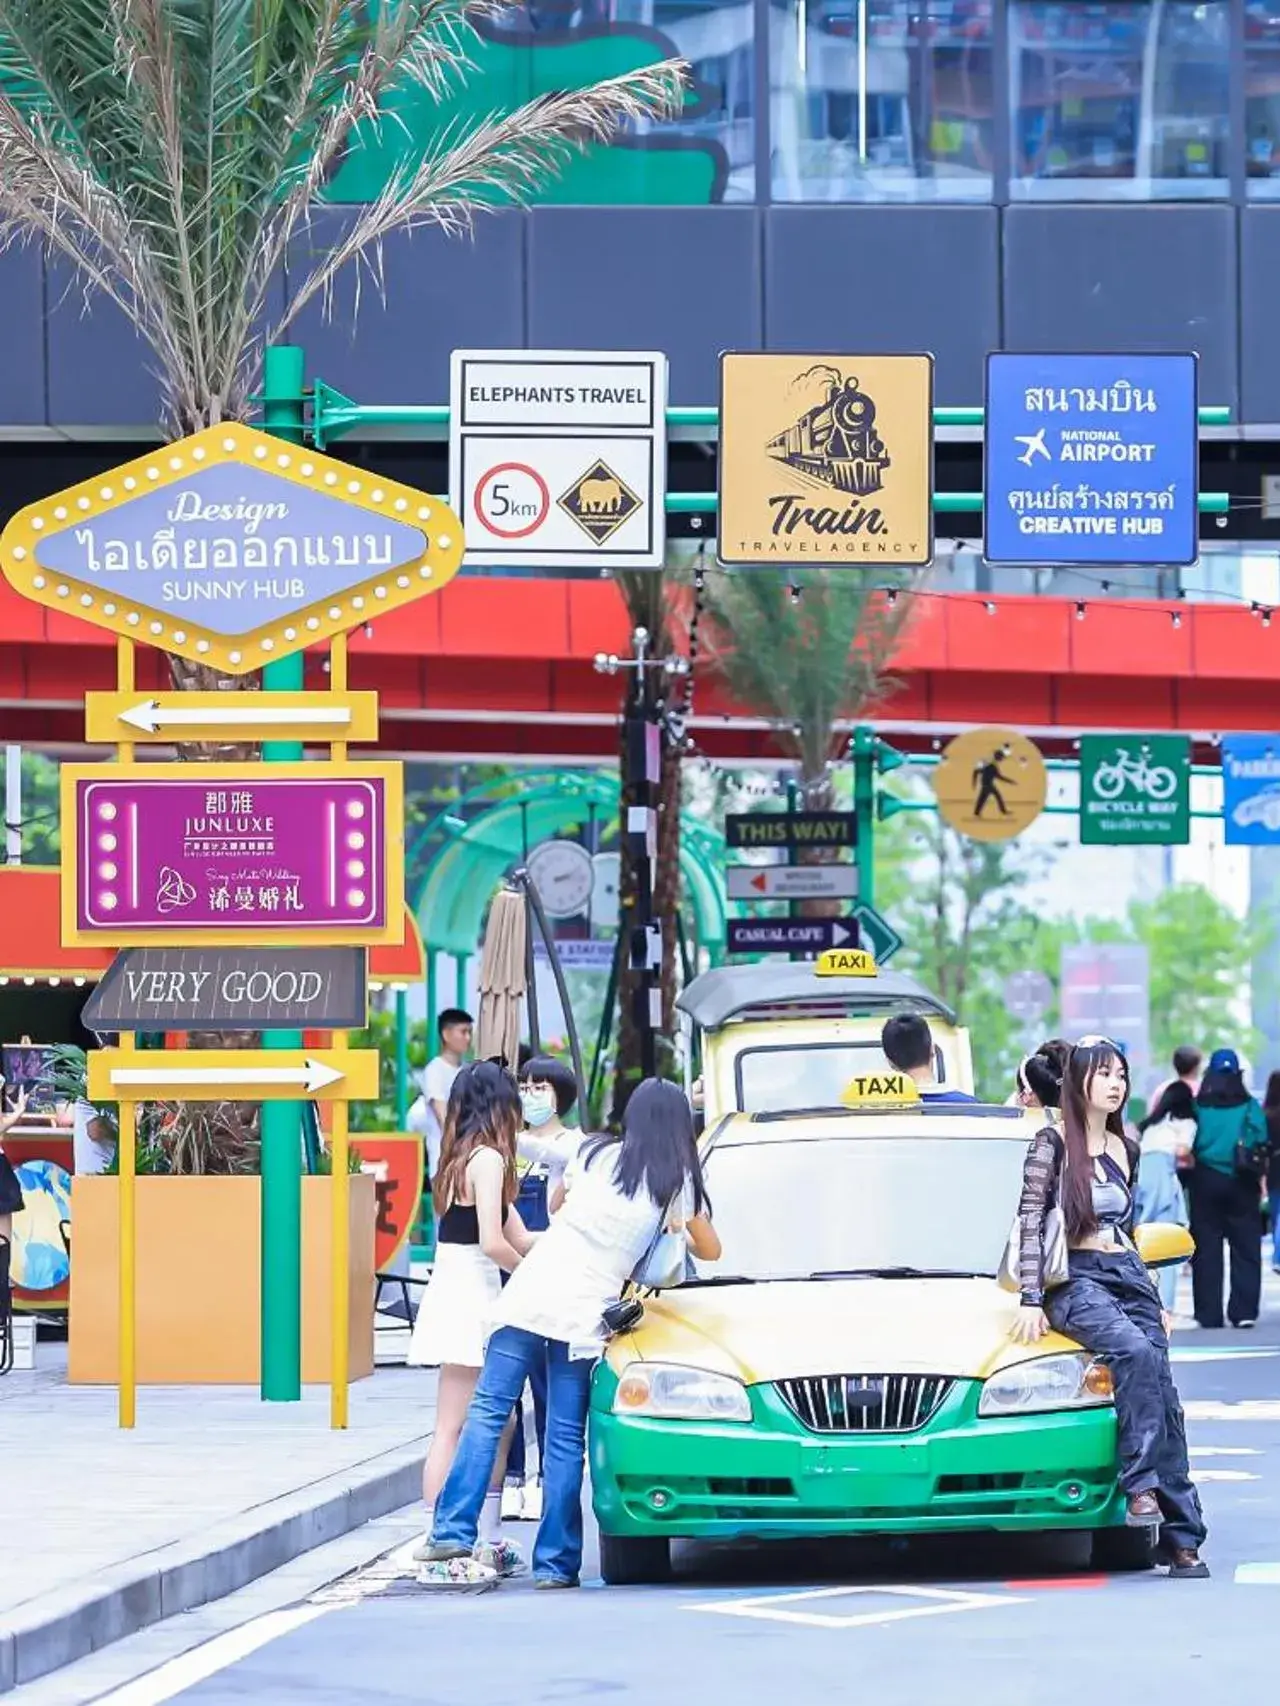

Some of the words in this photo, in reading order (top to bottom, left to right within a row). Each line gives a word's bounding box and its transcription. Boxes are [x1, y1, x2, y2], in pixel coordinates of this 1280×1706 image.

[470, 387, 575, 403] ELEPHANTS
[579, 387, 646, 404] TRAVEL
[1024, 380, 1157, 412] สนามบิน
[1061, 431, 1122, 441] NATIONAL
[1060, 444, 1155, 461] AIRPORT
[1008, 483, 1176, 516] ศูนย์สร้างสรรค์
[167, 491, 289, 533] Design
[768, 495, 888, 535] Train.
[1019, 517, 1116, 534] CREATIVE
[1122, 517, 1163, 535] HUB
[74, 526, 392, 571] ไอเดียออกแบบ
[162, 581, 248, 601] SUNNY
[254, 579, 305, 599] HUB
[1087, 801, 1143, 814] BICYCLE
[1148, 801, 1179, 814] WAY
[185, 817, 274, 835] JUNLUXE
[737, 822, 787, 840] THIS
[735, 927, 787, 942] CASUAL
[788, 926, 824, 941] CAFE
[828, 955, 866, 968] TAXI
[126, 971, 210, 1002] VERY
[222, 971, 322, 1002] GOOD
[854, 1076, 904, 1096] TAXI
